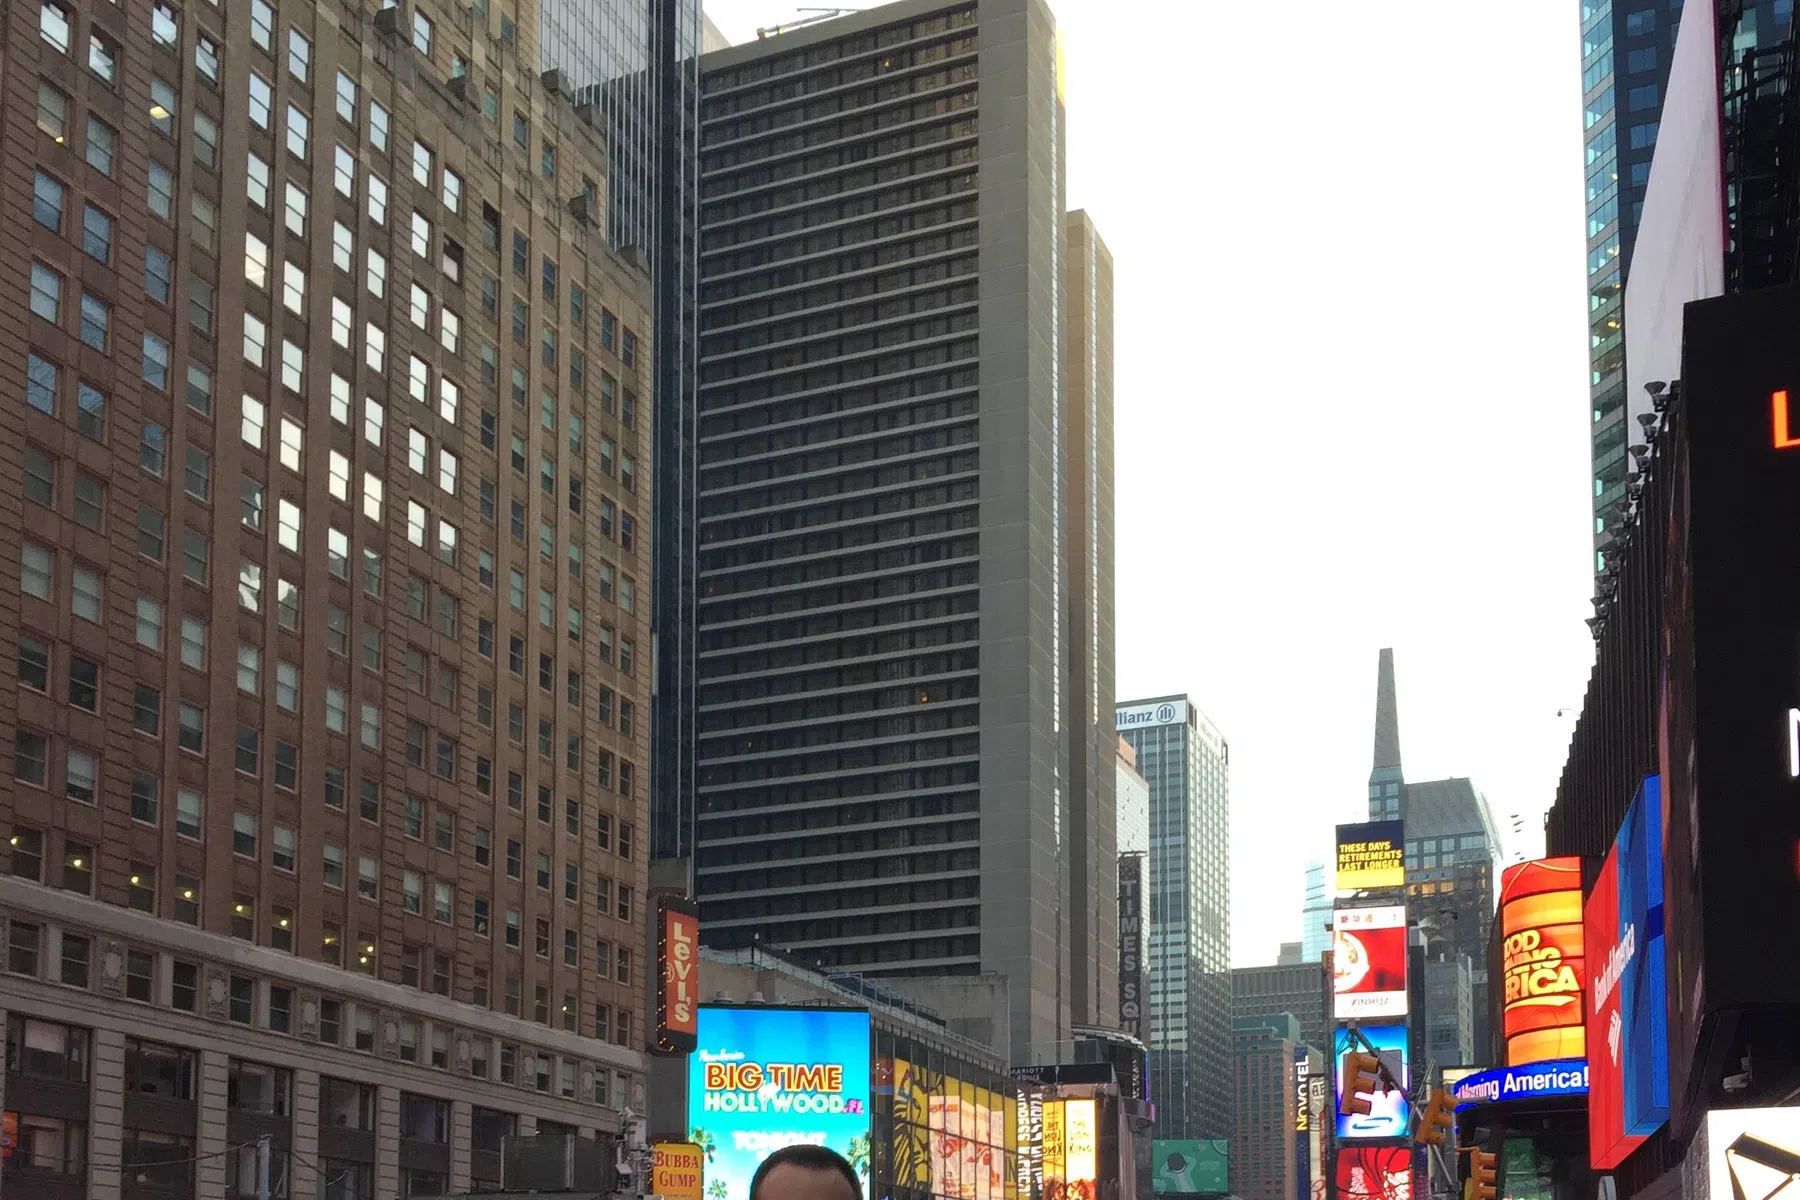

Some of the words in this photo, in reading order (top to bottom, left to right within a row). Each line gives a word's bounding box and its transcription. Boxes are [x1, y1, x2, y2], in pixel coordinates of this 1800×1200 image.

[1115, 711, 1153, 725] llianz
[1339, 843, 1366, 854] THESE
[1368, 841, 1391, 851] DAYS
[1339, 849, 1403, 863] RETIREMENTS
[1339, 861, 1362, 872] LAST
[1364, 859, 1400, 870] LONGER
[1120, 879, 1139, 972] TIMES
[1504, 929, 1541, 960] OOD
[1505, 965, 1581, 1004] RICA
[1121, 983, 1140, 1037] SQU
[705, 1062, 764, 1091] BIG
[767, 1063, 843, 1092] TIME
[1503, 1066, 1589, 1094] America!
[1295, 1055, 1309, 1131] NOVOTEL
[655, 1151, 699, 1168] BUBBA
[659, 1171, 697, 1188] GUMP
